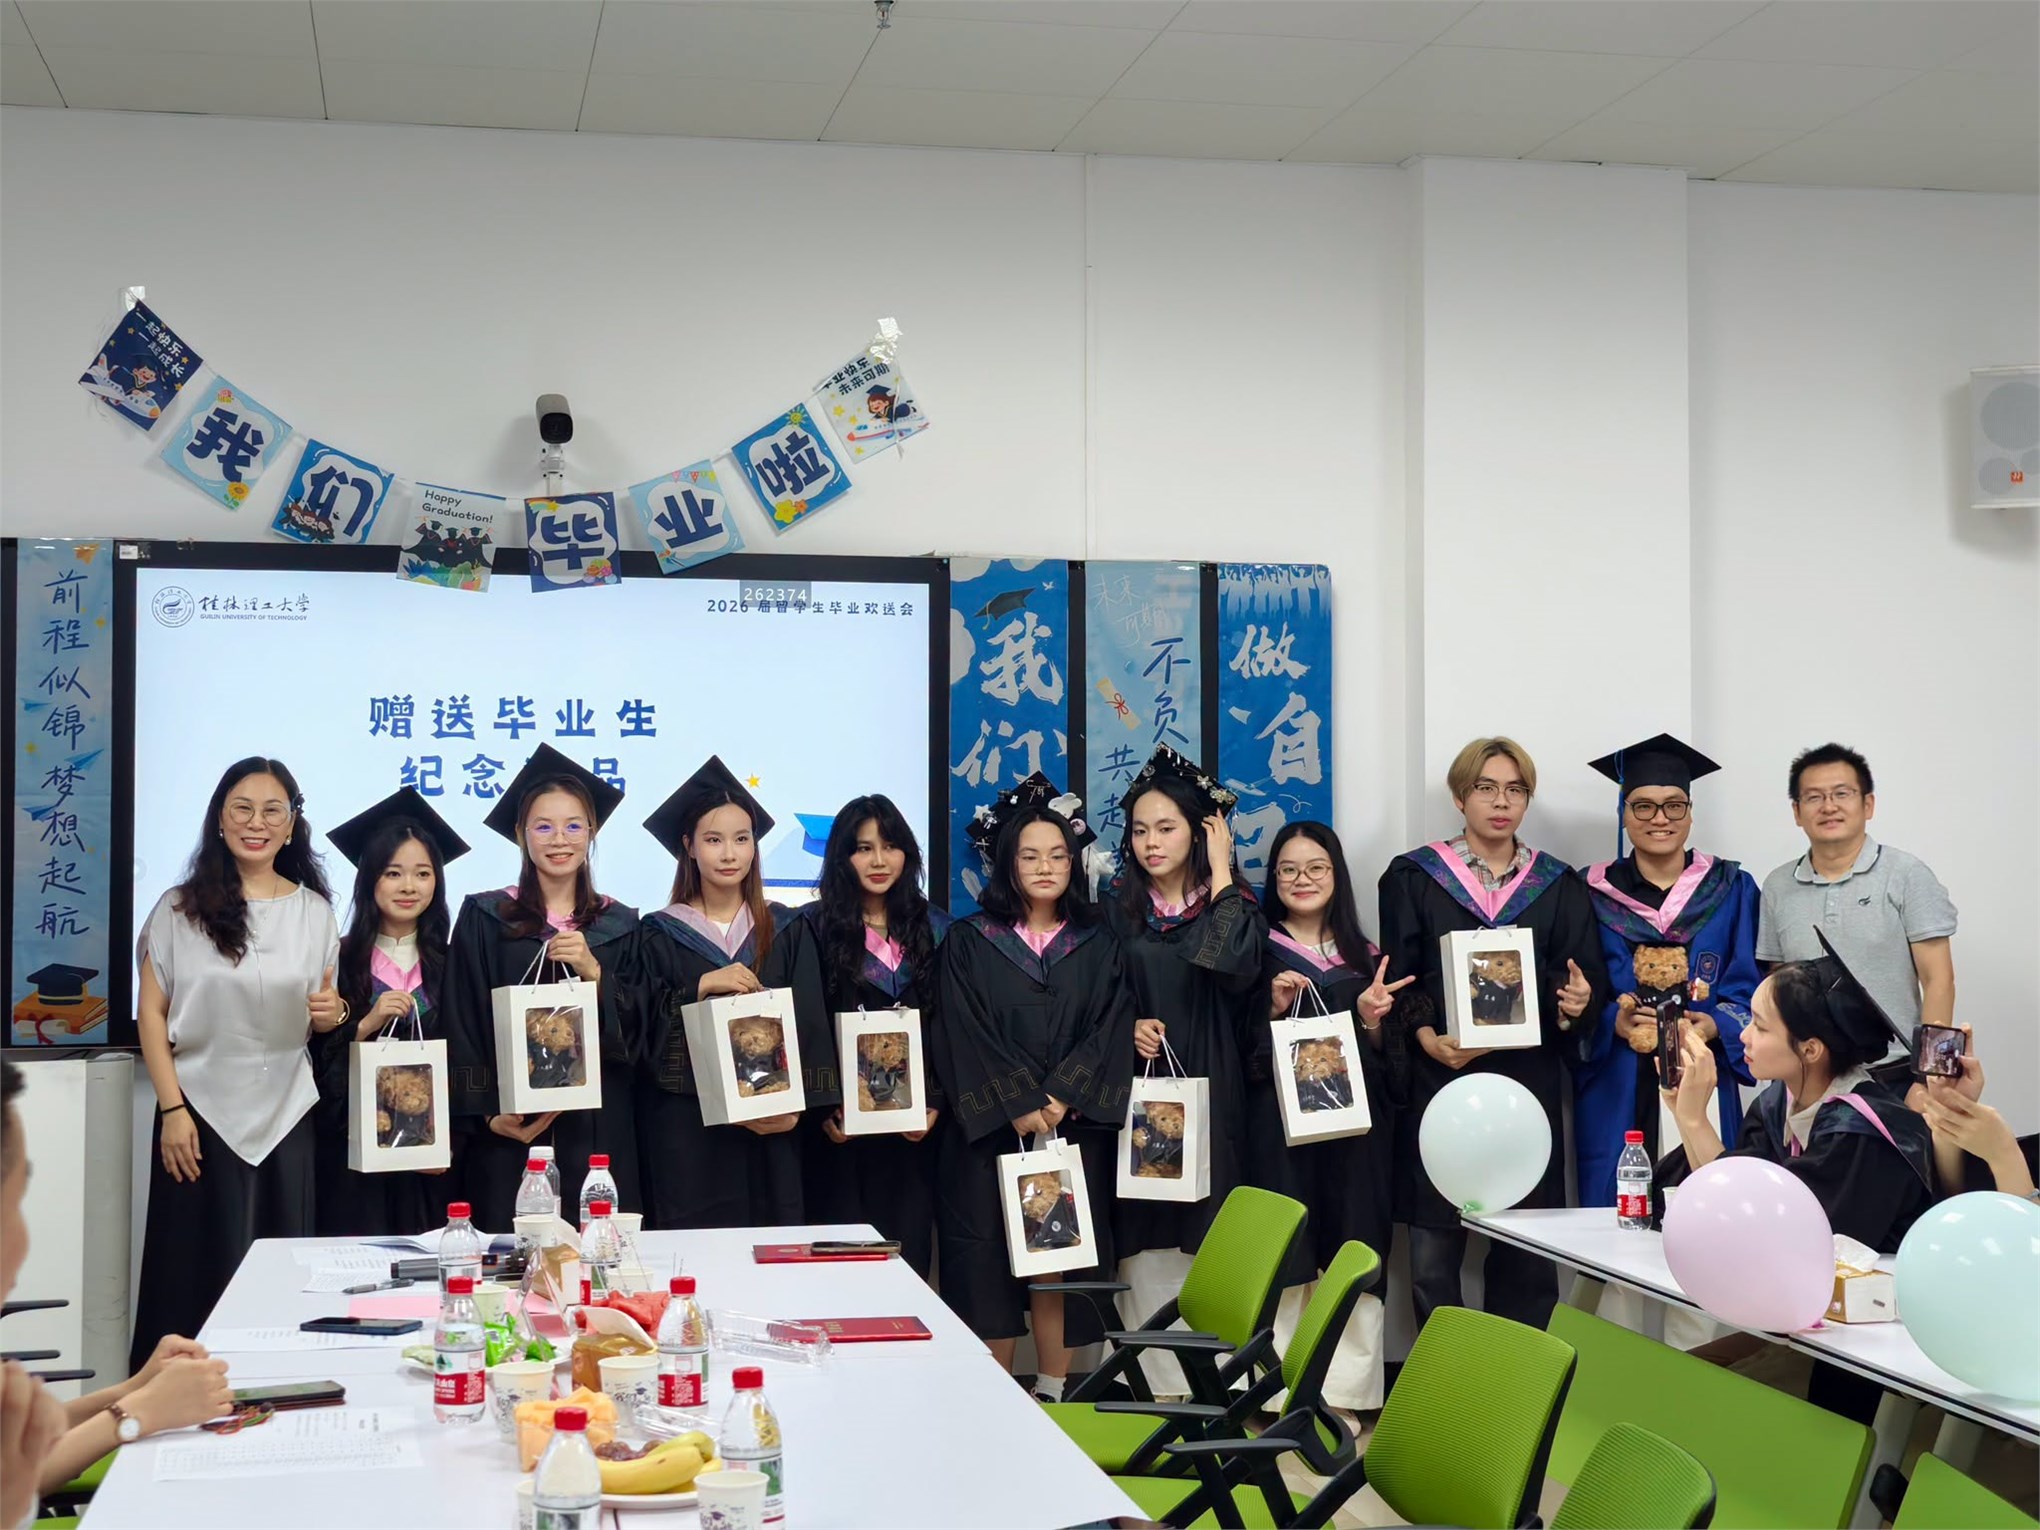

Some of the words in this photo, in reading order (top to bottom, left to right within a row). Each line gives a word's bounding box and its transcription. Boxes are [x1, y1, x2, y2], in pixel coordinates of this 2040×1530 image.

[136, 312, 183, 357] 一起快乐
[138, 332, 184, 378] 一起成长
[838, 363, 890, 395] 未来可期
[425, 490, 462, 507] Happy
[422, 503, 493, 523] Graduation!
[199, 593, 310, 612] 桂林理工大学
[707, 600, 749, 612] 2026
[743, 588, 808, 601] 262374
[369, 694, 657, 740] 赠送毕业生
[400, 753, 626, 798] 纪念品
